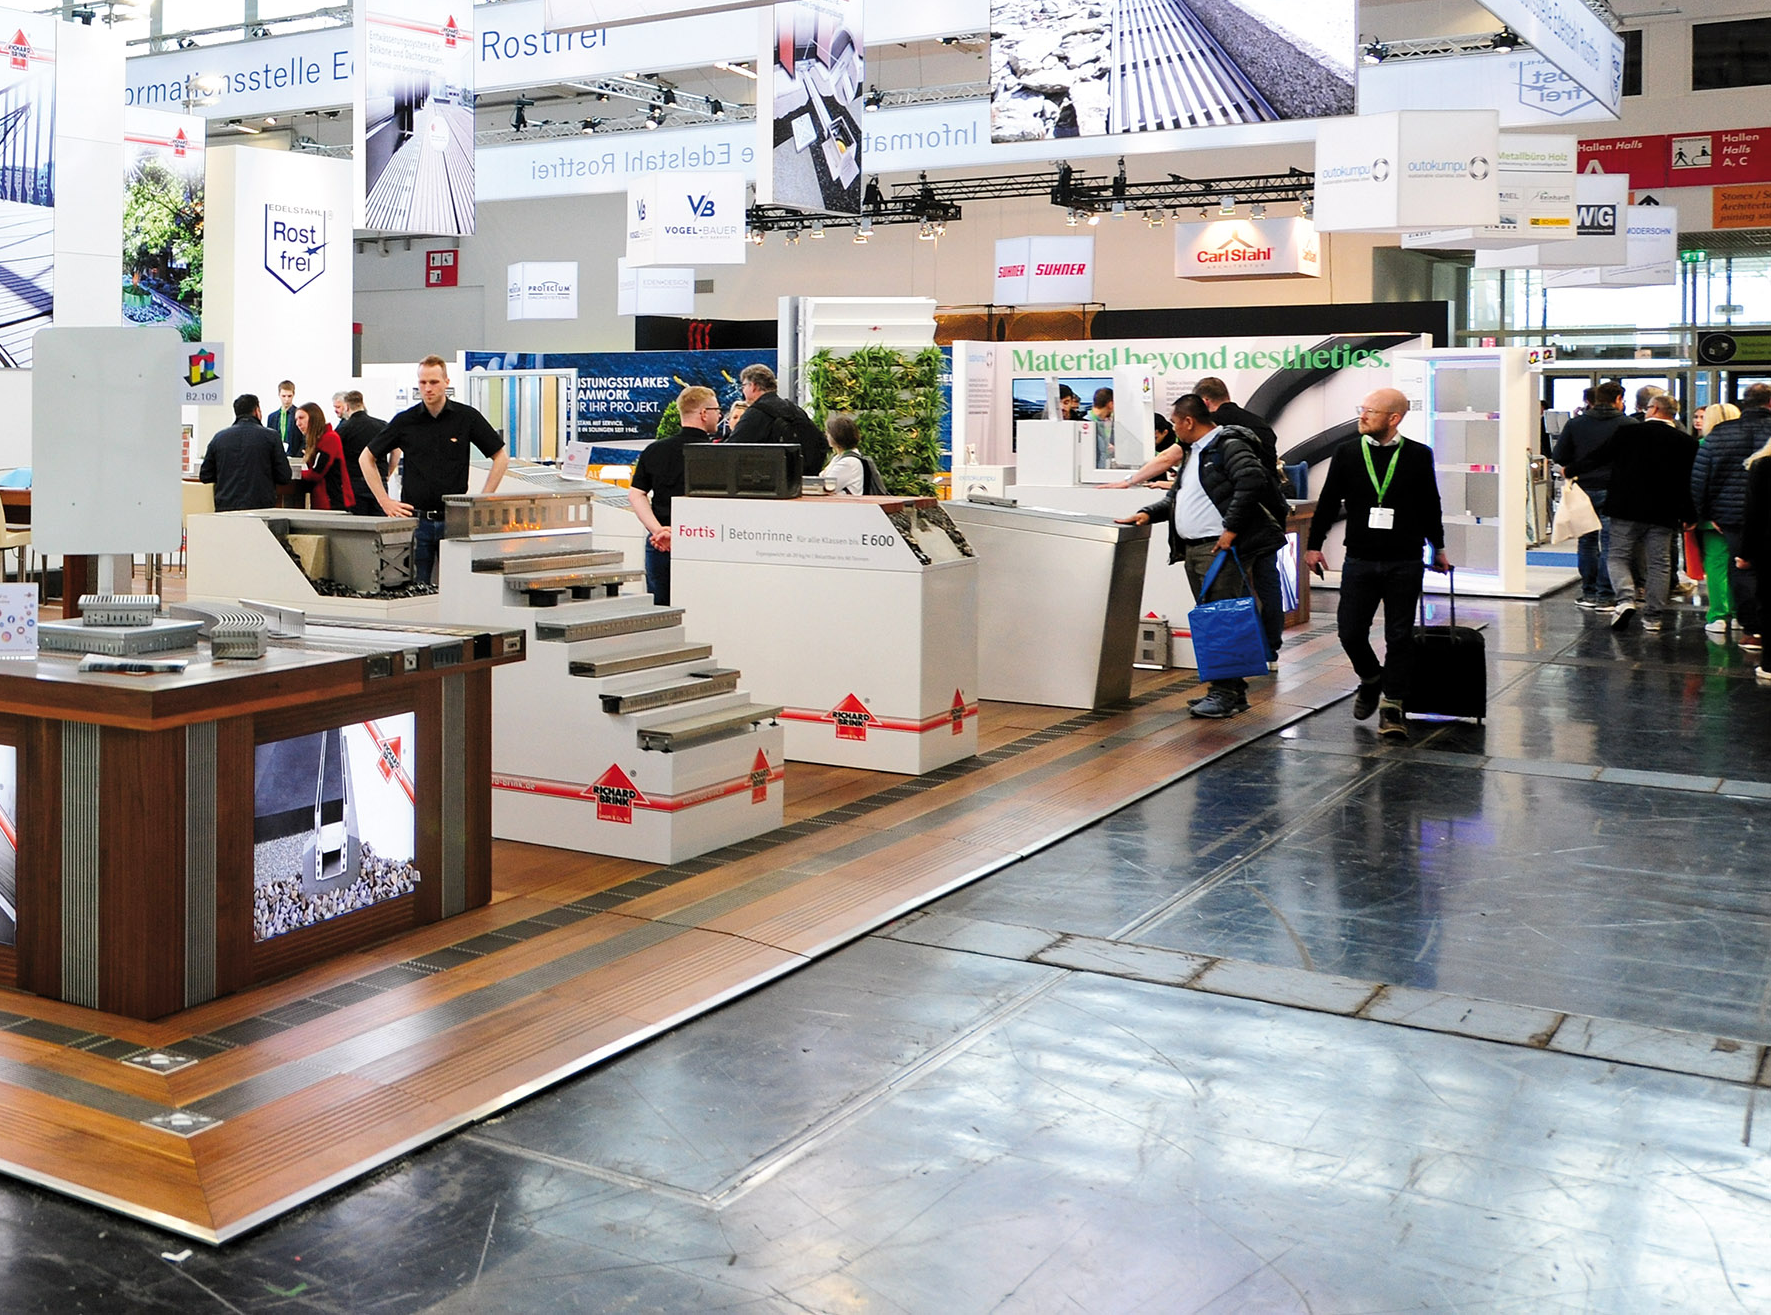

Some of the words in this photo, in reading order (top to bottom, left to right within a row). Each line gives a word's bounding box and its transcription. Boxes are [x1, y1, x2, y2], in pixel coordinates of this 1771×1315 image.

[1722, 133, 1759, 143] Hallen
[1578, 143, 1612, 154] Hallen
[1616, 140, 1643, 151] Halls
[1722, 145, 1751, 155] Halls
[1548, 153, 1568, 161] Holz
[1739, 157, 1748, 166] C
[1322, 165, 1370, 180] outokumpu
[1408, 160, 1467, 173] outokumpu
[267, 203, 324, 217] EDELSTAHL
[273, 221, 317, 245] Rost
[665, 226, 737, 235] VOGEL-BAUER
[280, 250, 311, 272] frei
[1035, 263, 1086, 276] SUHNER
[528, 283, 570, 292] PROTECTUM
[1012, 344, 1116, 373] Material
[1123, 343, 1228, 376] beyond
[1233, 343, 1390, 371] aesthetics.
[185, 392, 217, 401] B2.109
[589, 401, 607, 412] IHR
[609, 401, 661, 413] PROJEKT.
[679, 525, 715, 538] Fortis
[729, 528, 793, 542] Betonrinne
[808, 536, 820, 544] alle
[821, 537, 848, 546] Klassen
[848, 538, 859, 546] bis
[861, 534, 868, 546] E
[870, 535, 895, 547] 600
[832, 711, 869, 721] RICHARD
[838, 718, 864, 727] BRINK
[593, 785, 636, 800] RICHARD
[599, 795, 629, 807] BRINK
